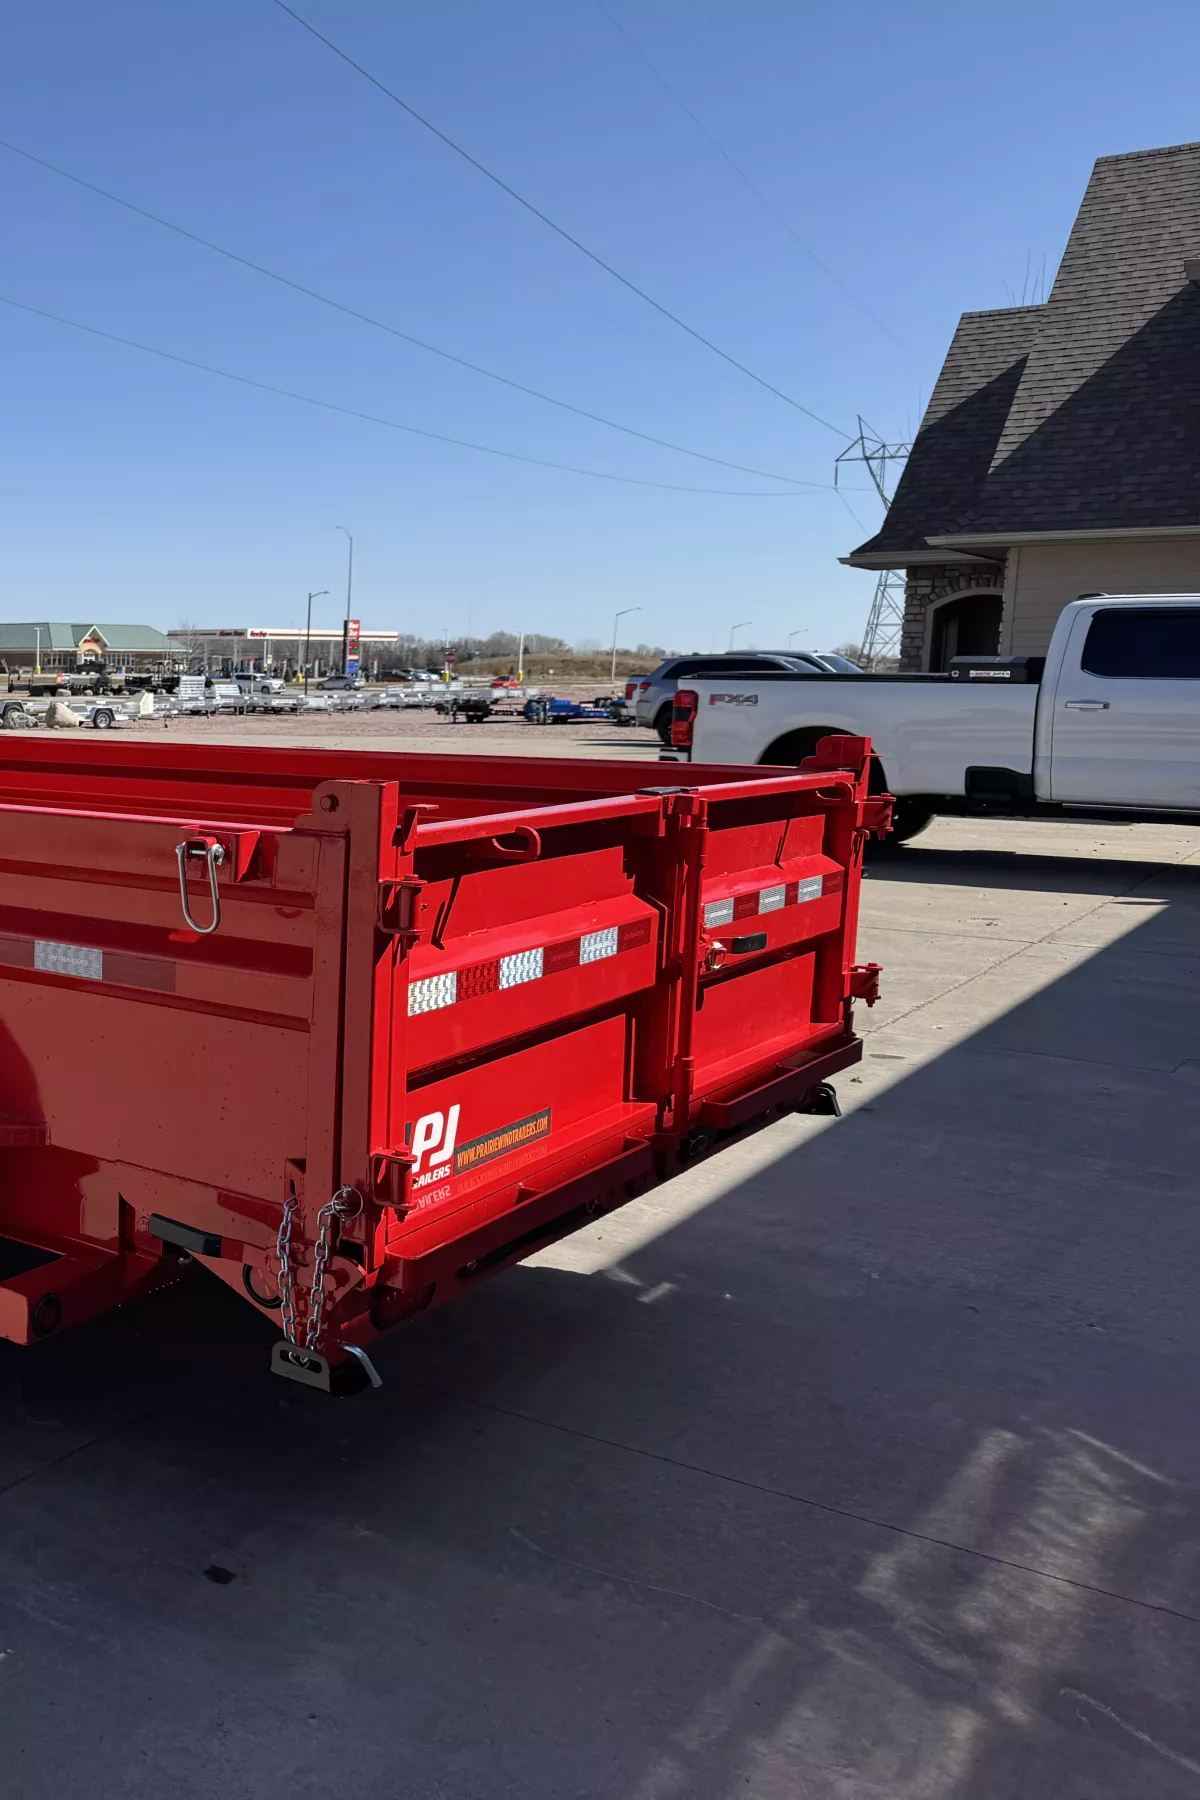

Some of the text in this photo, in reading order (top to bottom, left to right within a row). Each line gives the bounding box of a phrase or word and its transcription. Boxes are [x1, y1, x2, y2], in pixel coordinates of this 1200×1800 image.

[709, 694, 759, 706] FX4
[411, 1103, 461, 1174] PJ
[457, 1116, 548, 1168] WWW.PRAIRIEWINDTRAILERS.COM
